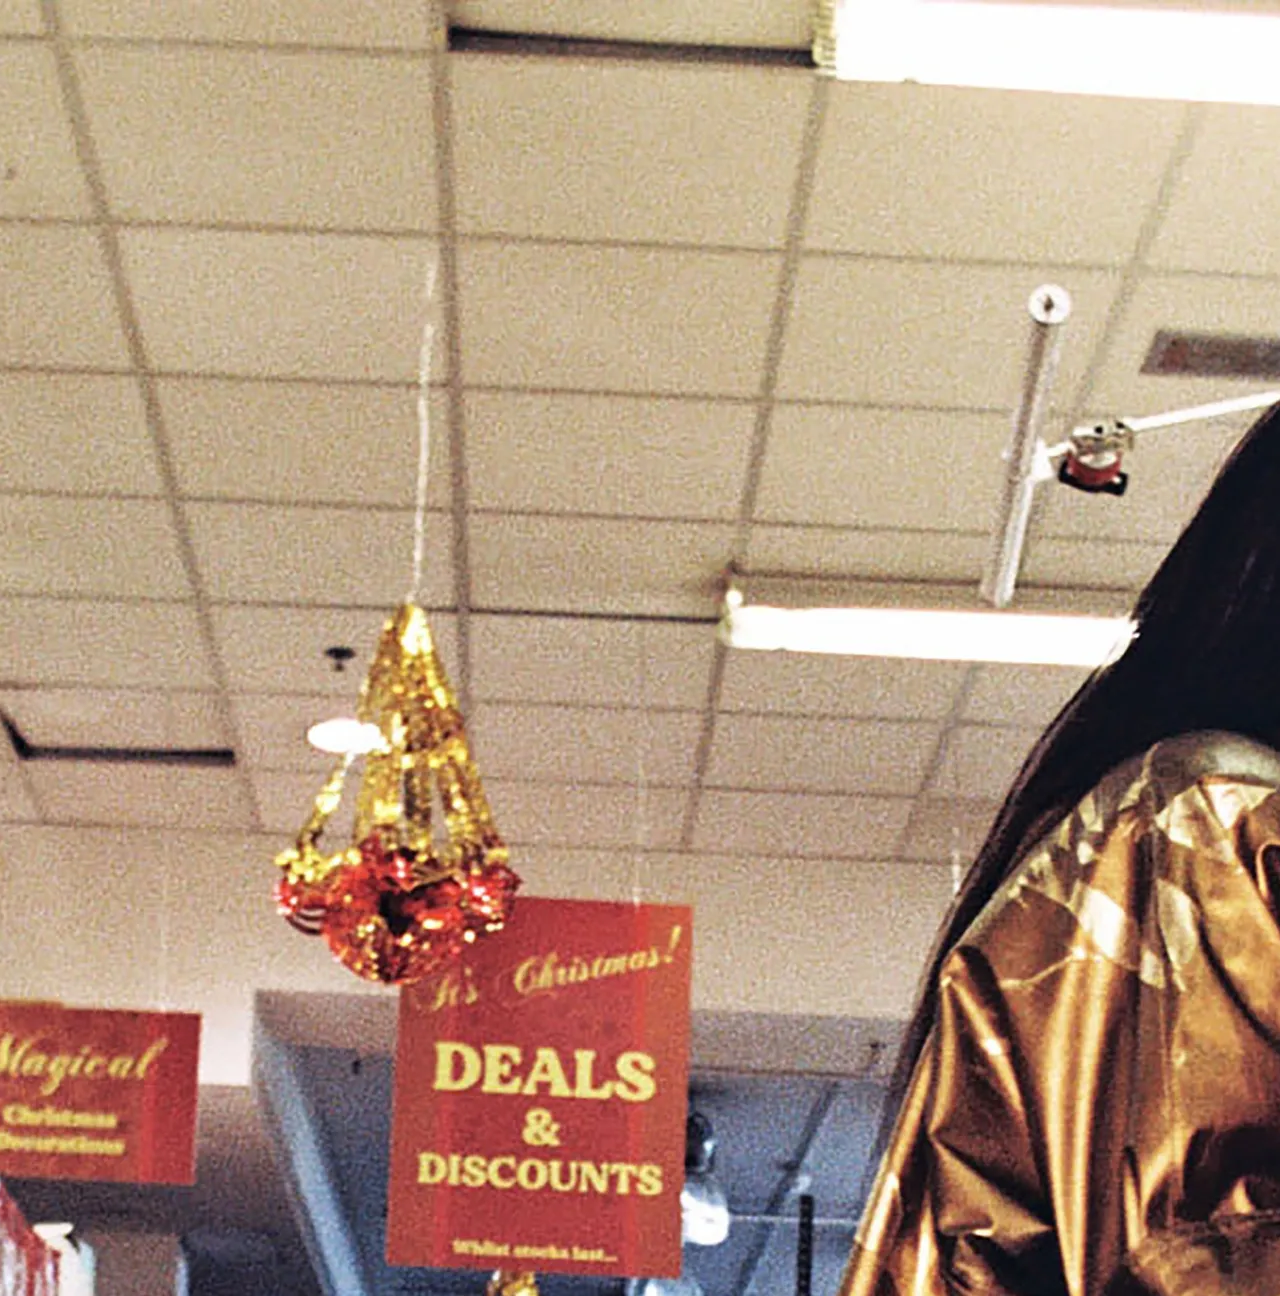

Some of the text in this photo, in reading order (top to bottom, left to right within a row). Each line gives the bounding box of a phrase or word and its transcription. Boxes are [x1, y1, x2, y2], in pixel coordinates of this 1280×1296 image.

[512, 924, 682, 996] Christmas!
[433, 1041, 657, 1102] DEALS
[521, 1107, 562, 1147] &
[417, 1152, 664, 1196] DISCOUNTS
[452, 1239, 509, 1257] Whilst
